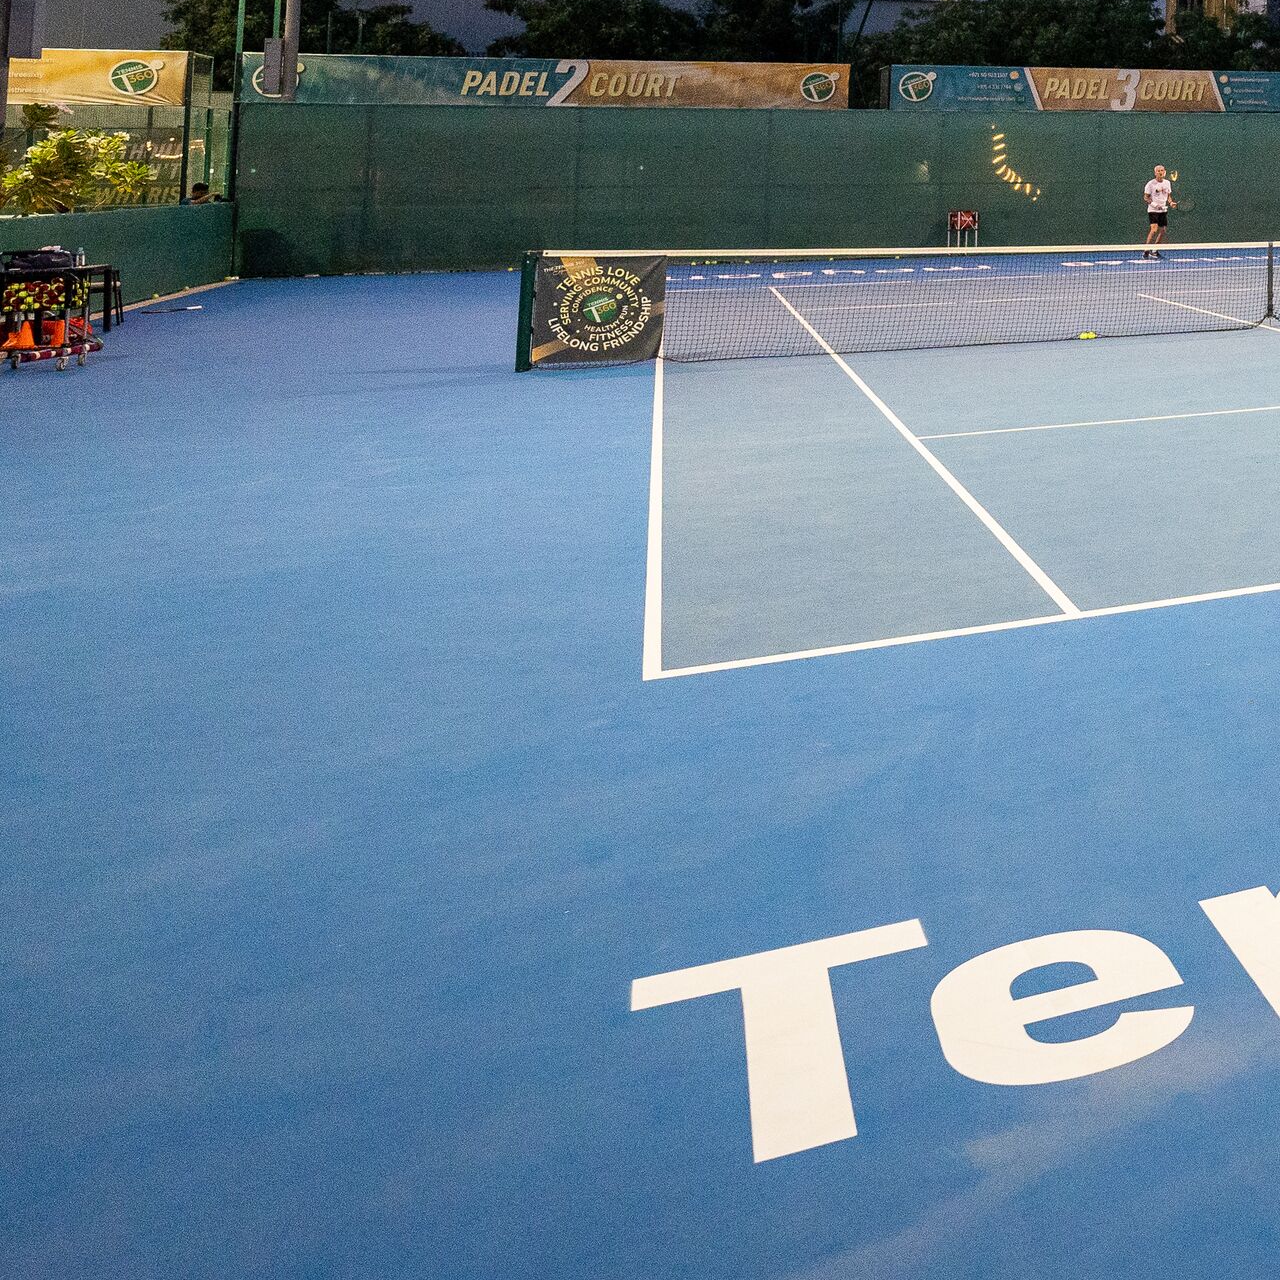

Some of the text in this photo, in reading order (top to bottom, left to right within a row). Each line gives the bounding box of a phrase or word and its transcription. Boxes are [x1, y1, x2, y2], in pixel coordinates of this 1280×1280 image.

[128, 70, 153, 84] 360
[460, 59, 683, 107] PADEL 2 COURT
[1043, 69, 1210, 111] PADEL 3 COURT
[556, 266, 604, 292] TENNIS
[607, 266, 641, 286] LOVE
[560, 276, 639, 326] SERVING COMMUNITY
[572, 286, 614, 313] CONFIDENCE
[597, 302, 617, 314] 360
[548, 296, 652, 352] LIFELONG FRIENDSHIP
[584, 305, 629, 333] HEALTHY FUN
[589, 319, 634, 341] FITNESS
